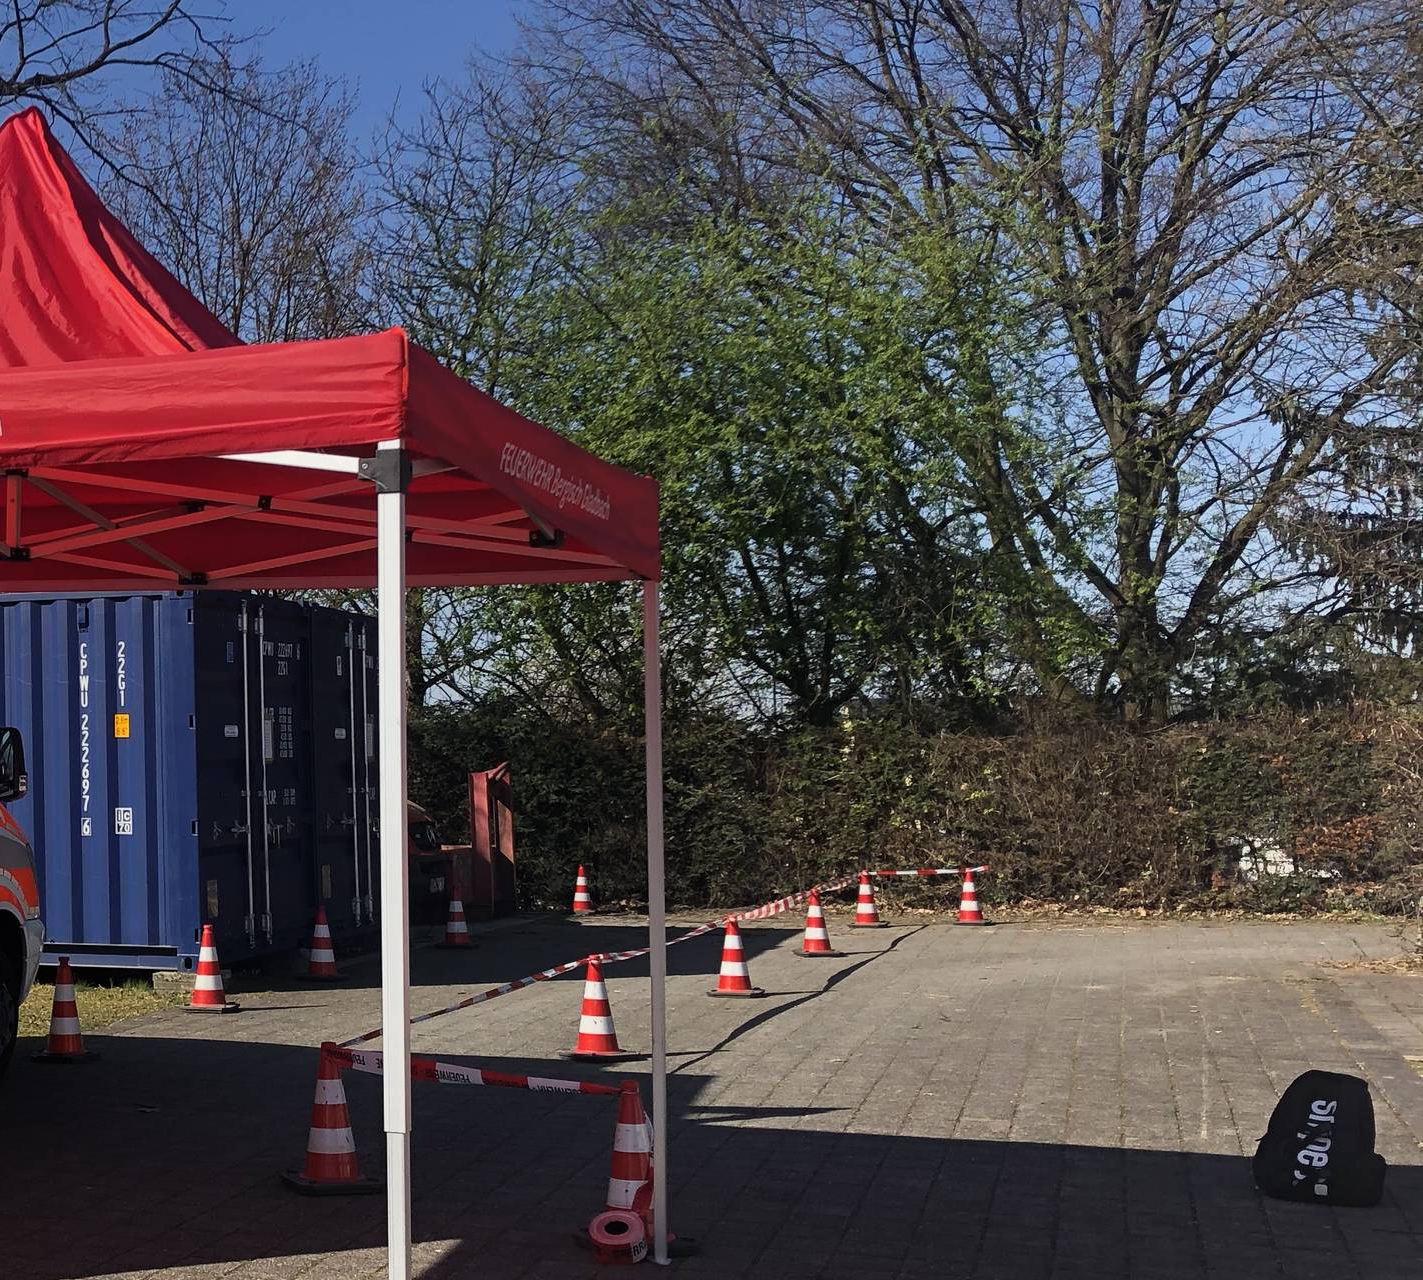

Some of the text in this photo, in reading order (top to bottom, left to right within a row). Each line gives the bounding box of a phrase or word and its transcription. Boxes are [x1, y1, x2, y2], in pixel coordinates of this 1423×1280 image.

[499, 442, 611, 521] FEUERWEHR Bergisch Gladbach
[79, 642, 89, 708] CPWU
[117, 641, 126, 707] 22G1
[80, 714, 90, 812] 222697
